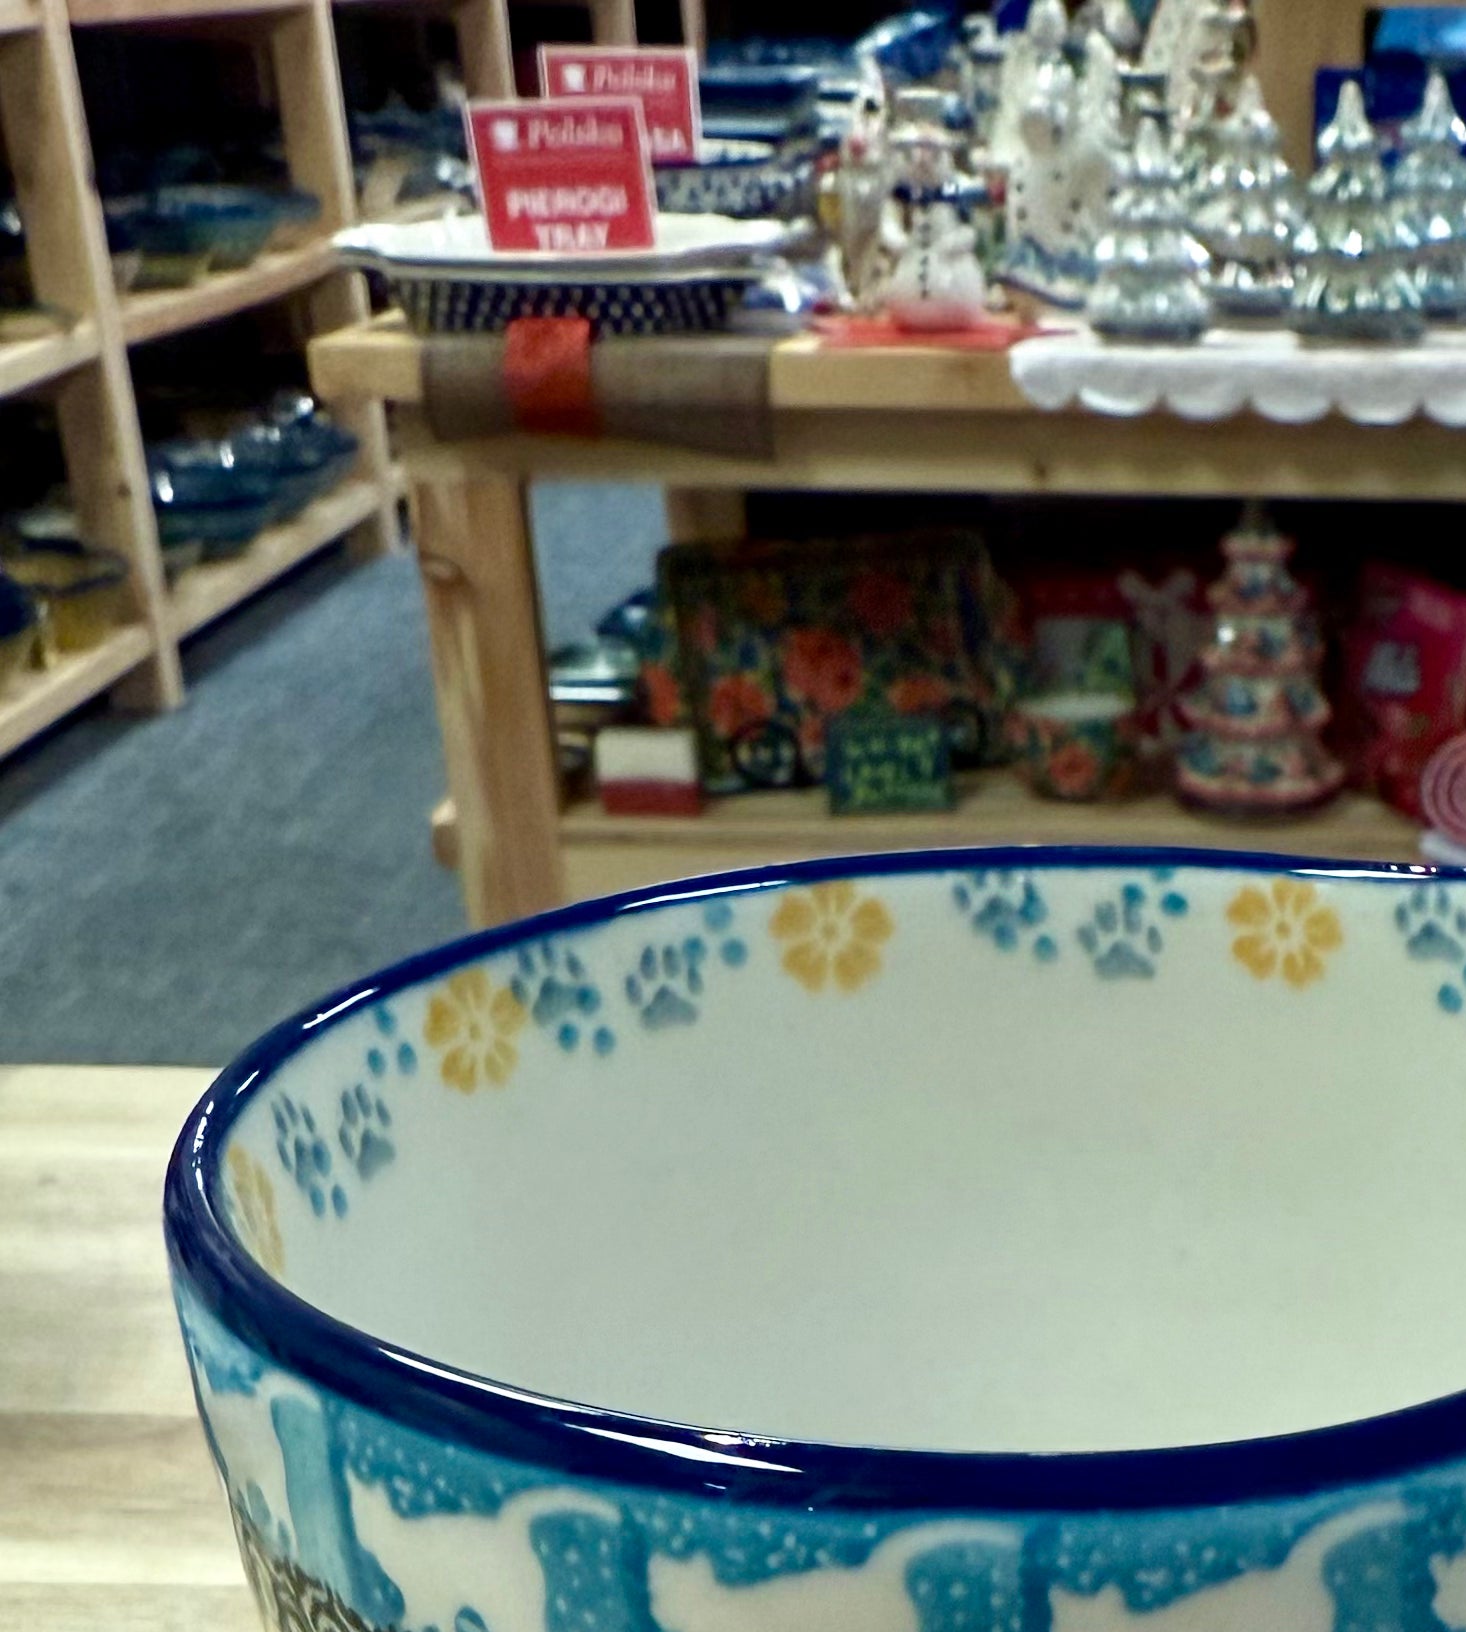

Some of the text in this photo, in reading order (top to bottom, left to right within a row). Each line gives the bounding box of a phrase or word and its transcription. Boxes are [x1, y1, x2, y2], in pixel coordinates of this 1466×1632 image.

[527, 114, 624, 151] Polska
[505, 185, 629, 221] PIEROGI
[533, 221, 610, 250] TRAY
